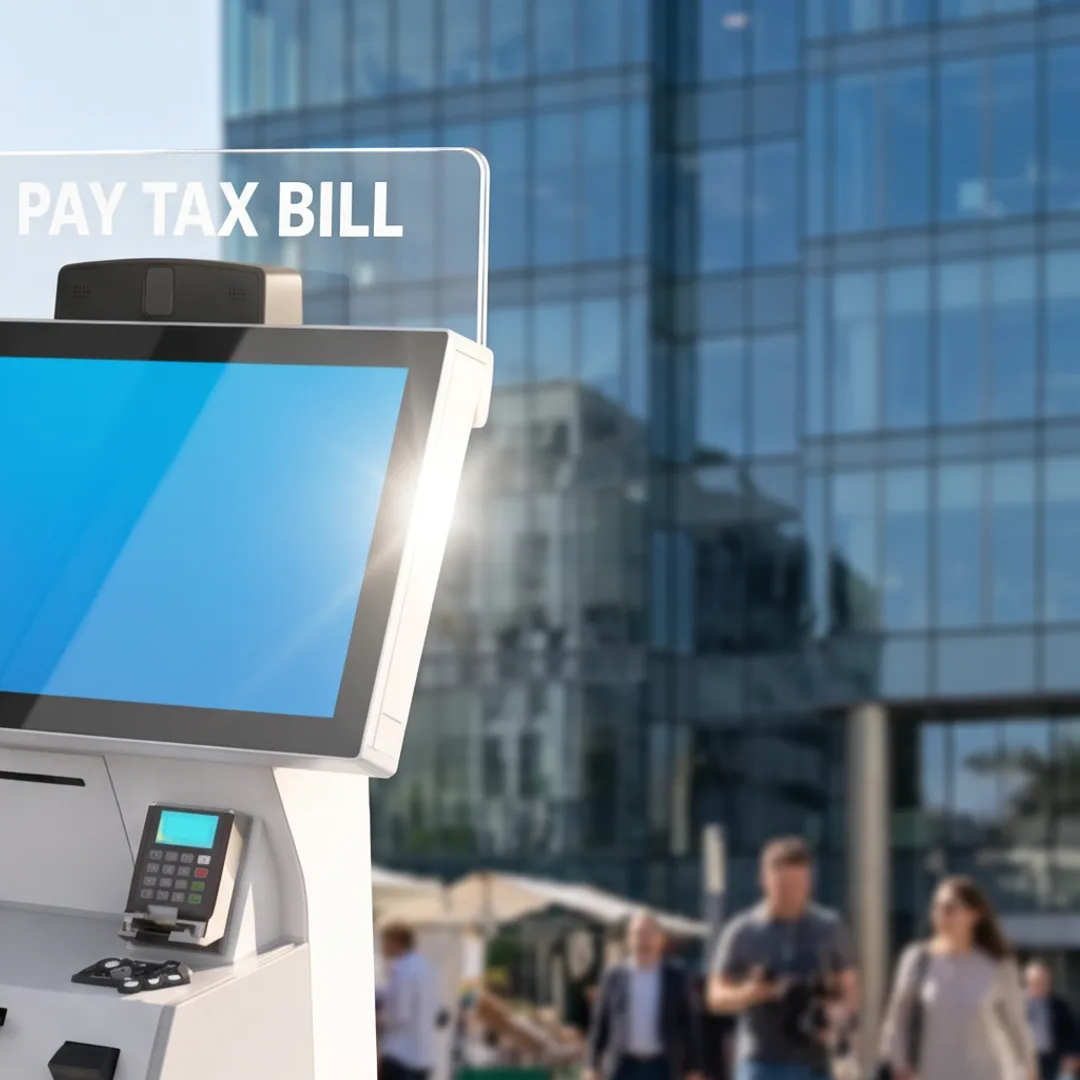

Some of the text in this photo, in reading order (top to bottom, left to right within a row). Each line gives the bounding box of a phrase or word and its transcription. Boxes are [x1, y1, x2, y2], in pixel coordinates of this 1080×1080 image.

[17, 181, 404, 238] PAY TAX BILL
